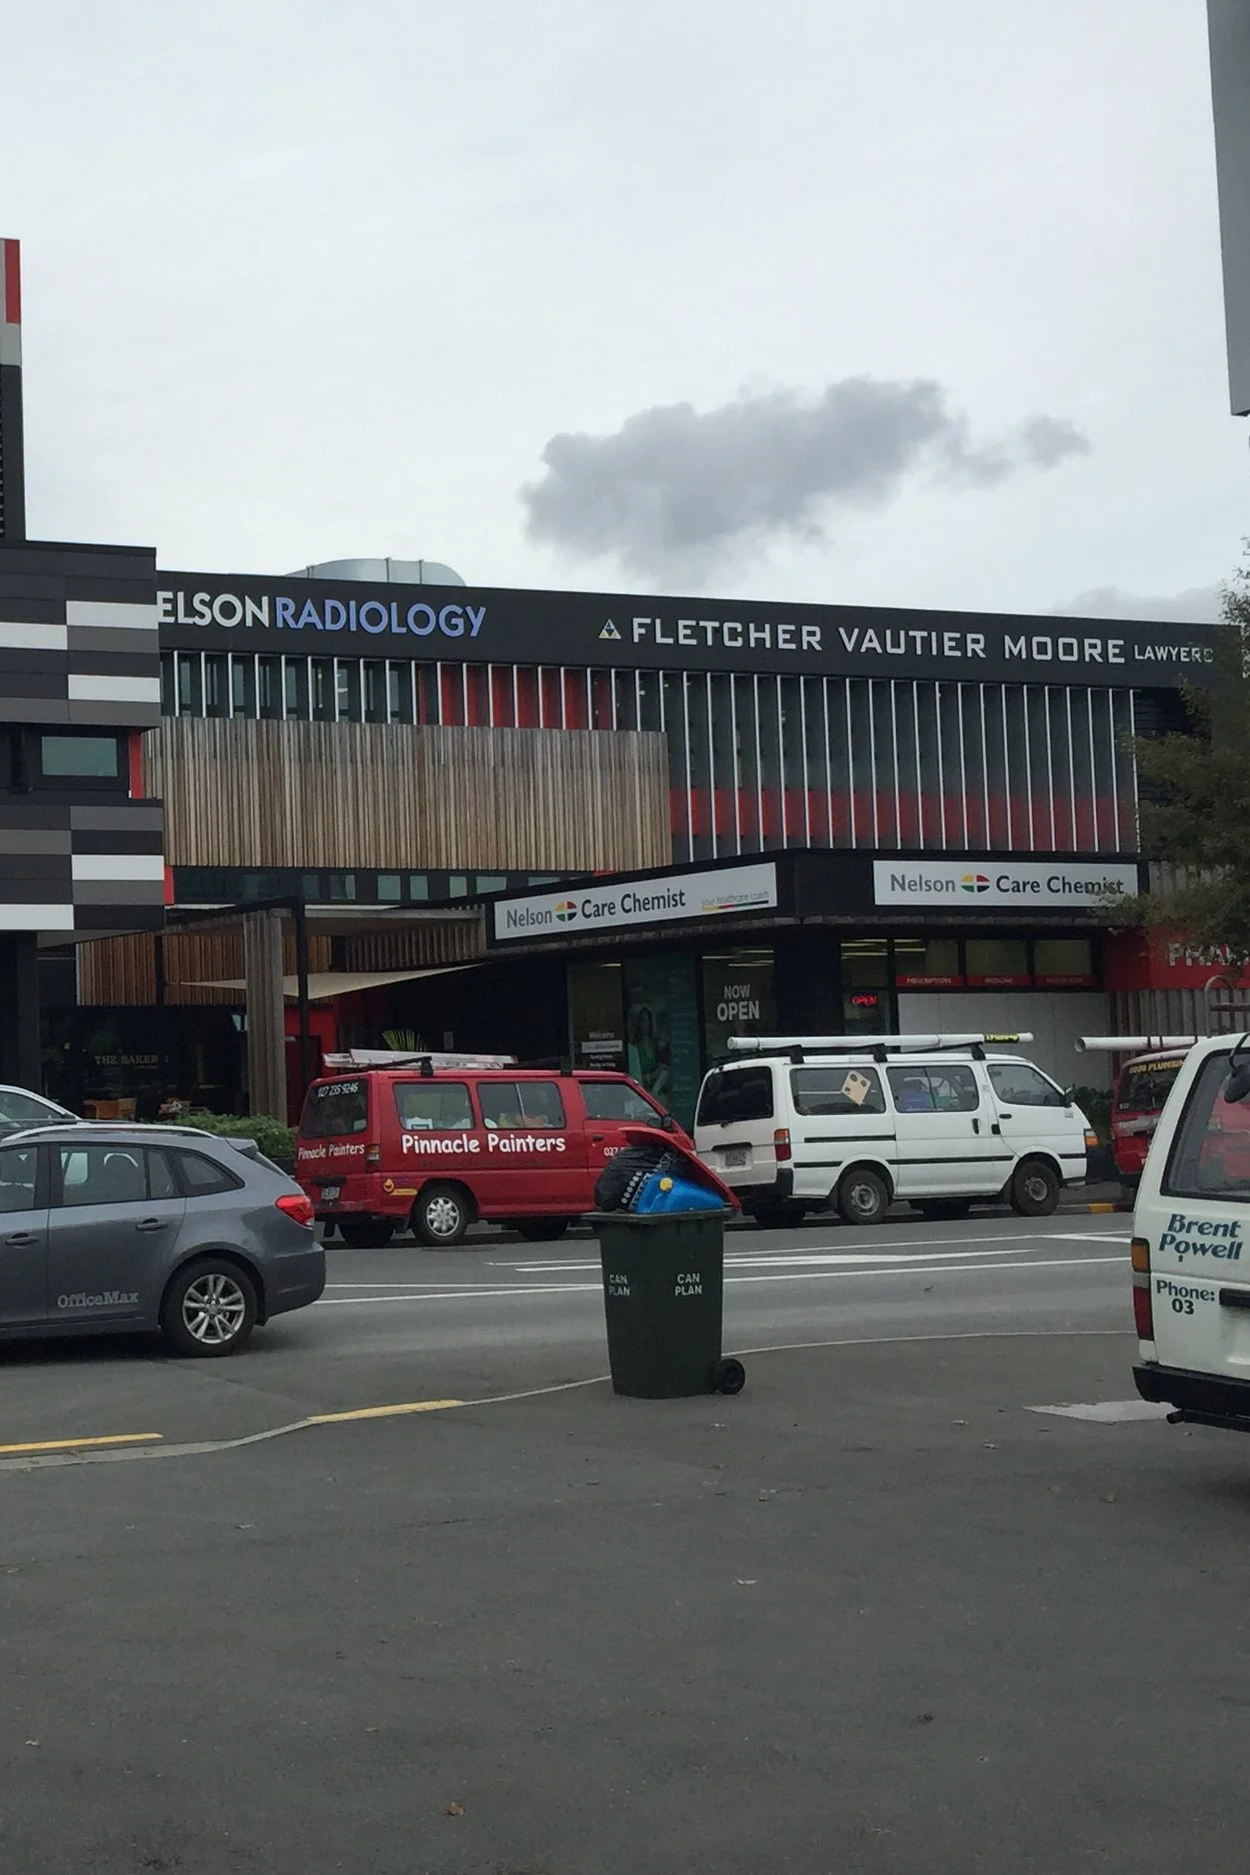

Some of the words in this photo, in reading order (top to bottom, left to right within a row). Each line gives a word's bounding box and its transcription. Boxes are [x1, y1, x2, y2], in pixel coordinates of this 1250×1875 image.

[156, 590, 486, 638] ELSONRADIOLOGY
[632, 617, 823, 651] FLETCHER
[837, 626, 986, 658] VAUTIER
[1004, 633, 1125, 663] MOORE
[890, 873, 956, 893] Nelson
[996, 875, 1041, 893] Care
[1046, 875, 1125, 895] Chemist
[506, 907, 553, 929] Nelson
[581, 898, 616, 920] Care
[621, 887, 686, 913] Chemist
[723, 983, 751, 1000] NOW
[852, 995, 878, 1006] OPEN
[716, 1000, 760, 1022] OPEN
[94, 1055, 118, 1065] THE
[298, 1144, 327, 1160] Pinnacle
[328, 1143, 366, 1157] Painters
[402, 1133, 480, 1154] Pinnacle
[488, 1133, 566, 1153] Painters
[1167, 1213, 1241, 1238] Brent
[1158, 1233, 1243, 1261] Powell
[609, 1274, 628, 1284] CAN
[677, 1272, 701, 1284] CAN
[57, 1290, 139, 1308] OfficeMax
[675, 1285, 702, 1296] PLAN
[1156, 1279, 1216, 1302] Phone:
[1171, 1298, 1195, 1315] 03
